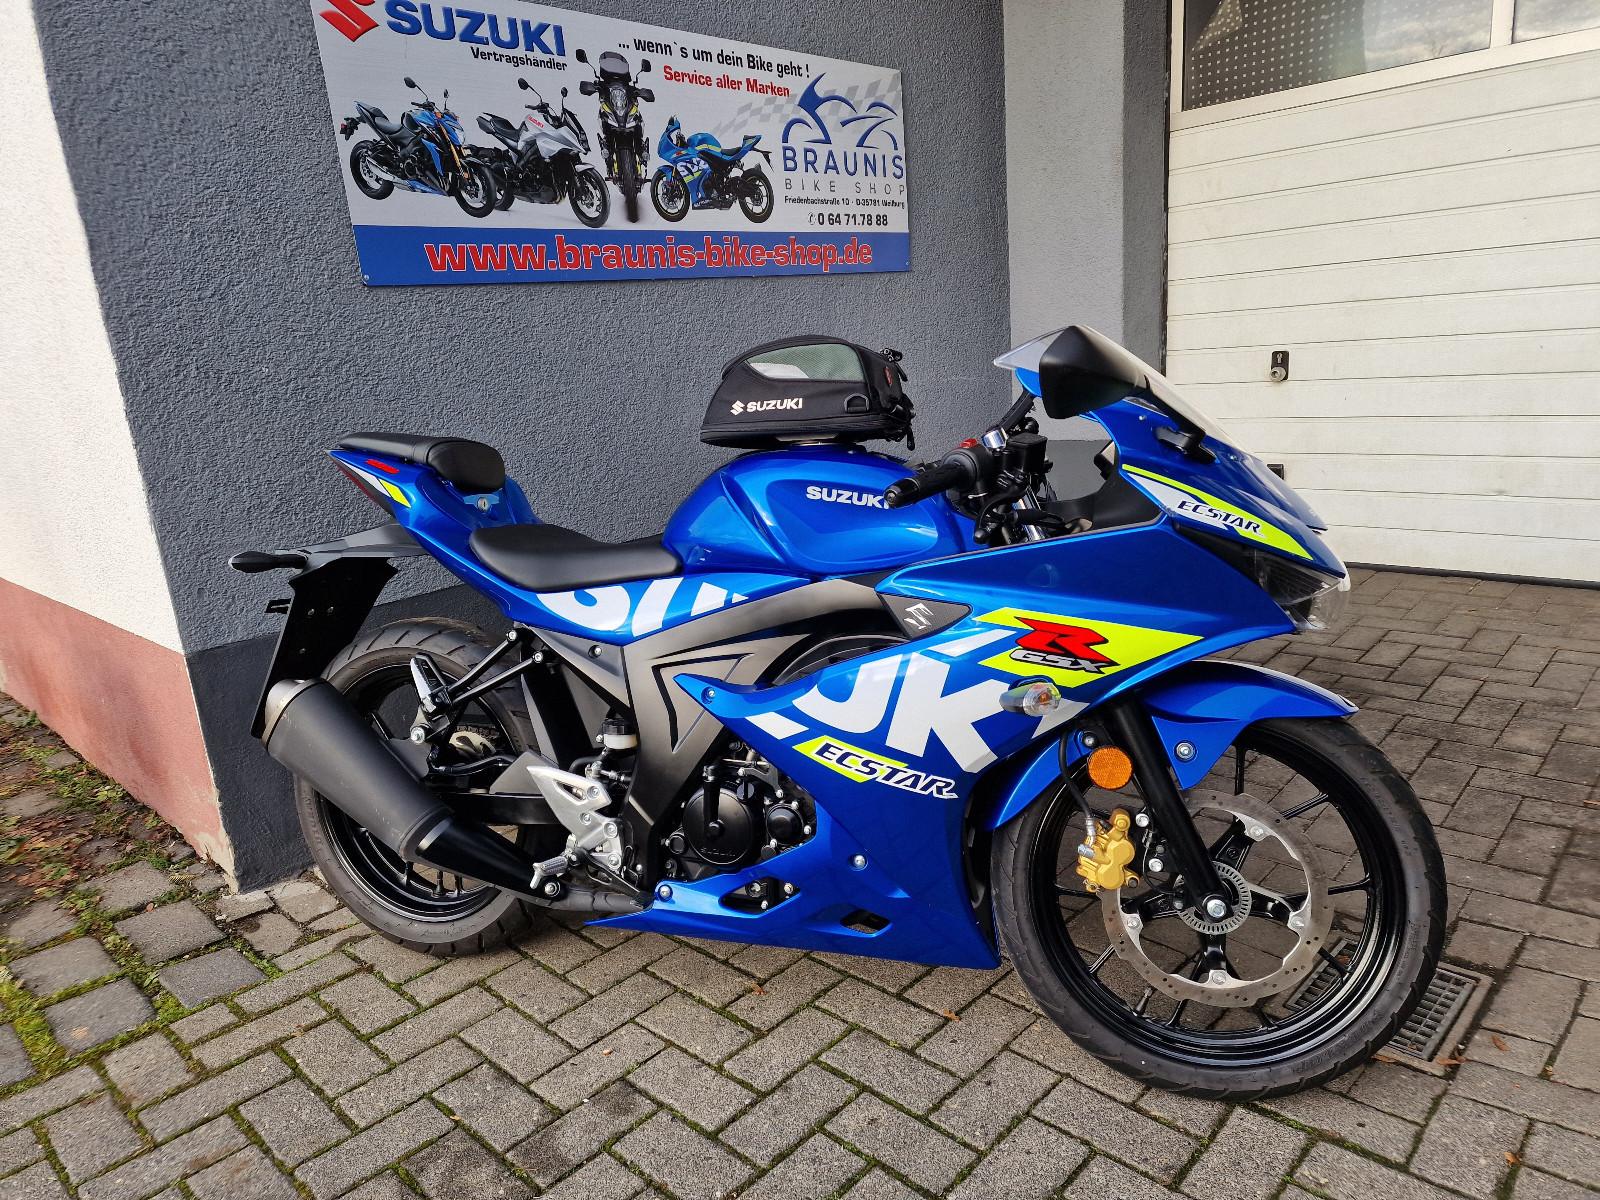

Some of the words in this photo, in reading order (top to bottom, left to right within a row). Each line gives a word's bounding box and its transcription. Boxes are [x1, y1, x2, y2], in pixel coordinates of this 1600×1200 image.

[384, 0, 566, 57] SUZUKI
[470, 46, 568, 71] Vertragshändler
[692, 48, 713, 63] um
[716, 49, 744, 68] dein
[746, 53, 774, 73] Bike
[776, 59, 803, 79] geht
[663, 64, 713, 87] Service
[716, 73, 743, 91] aller
[745, 77, 791, 98] Marken
[782, 145, 904, 180] BRAUNIS
[784, 178, 836, 193] BIKE
[855, 181, 905, 196] SHOP
[424, 234, 873, 272] www.braunis-bike-shop.de
[746, 397, 803, 412] SUZUKI
[1177, 500, 1263, 534] ECSTAR
[1009, 648, 1106, 674] GSX
[814, 739, 958, 799] ECSTAR
